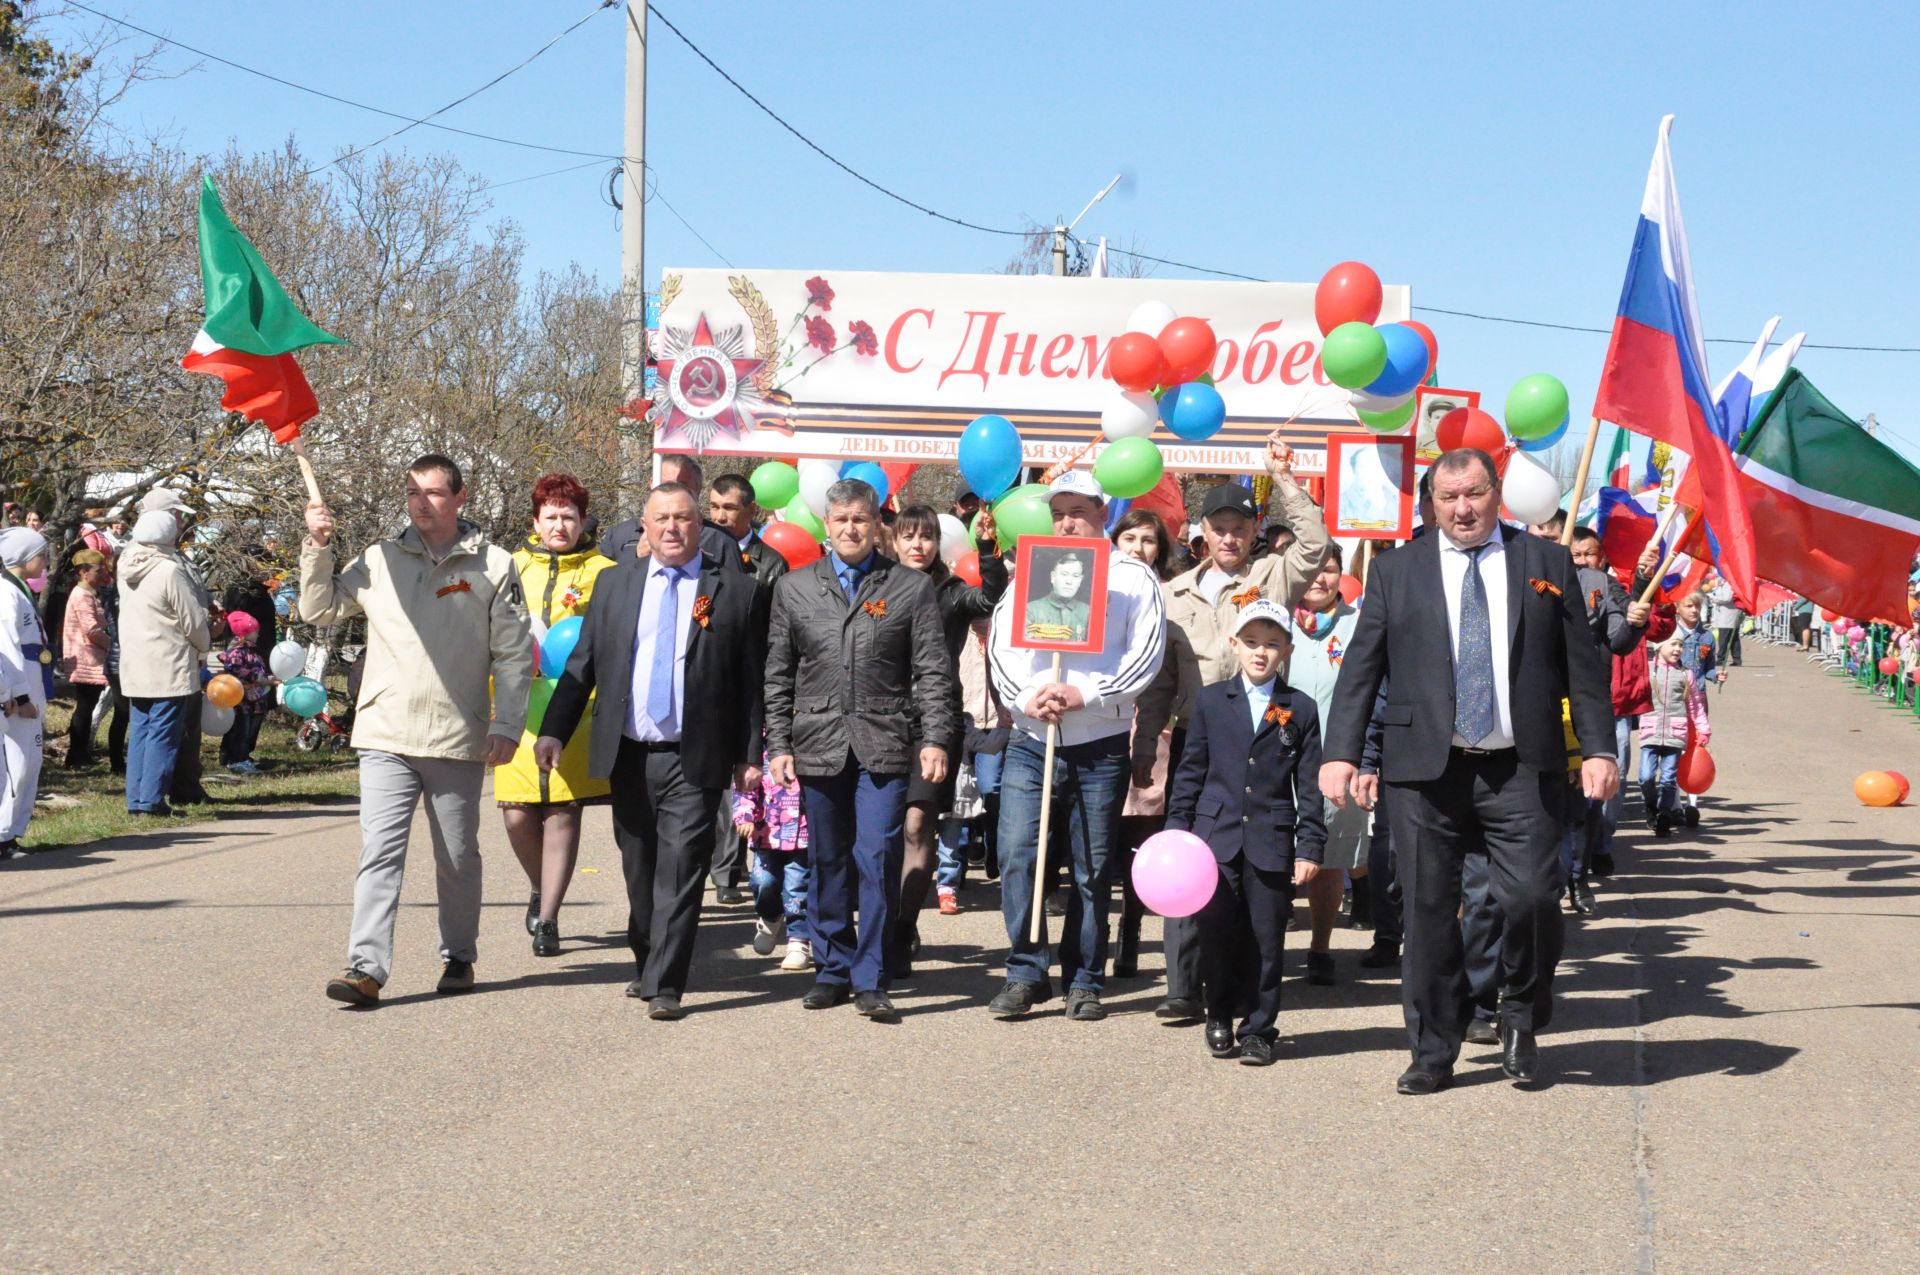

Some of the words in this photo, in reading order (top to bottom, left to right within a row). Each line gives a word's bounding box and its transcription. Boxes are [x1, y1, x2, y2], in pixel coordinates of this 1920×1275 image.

[884, 308, 935, 374] С
[937, 311, 1120, 392] Днем
[1197, 318, 1333, 386] обе
[840, 437, 889, 453] ДЕНЬ
[894, 439, 959, 457] ПОБЕД
[1023, 444, 1045, 458] АЯ
[1160, 448, 1256, 465] ПОМНИМ.
